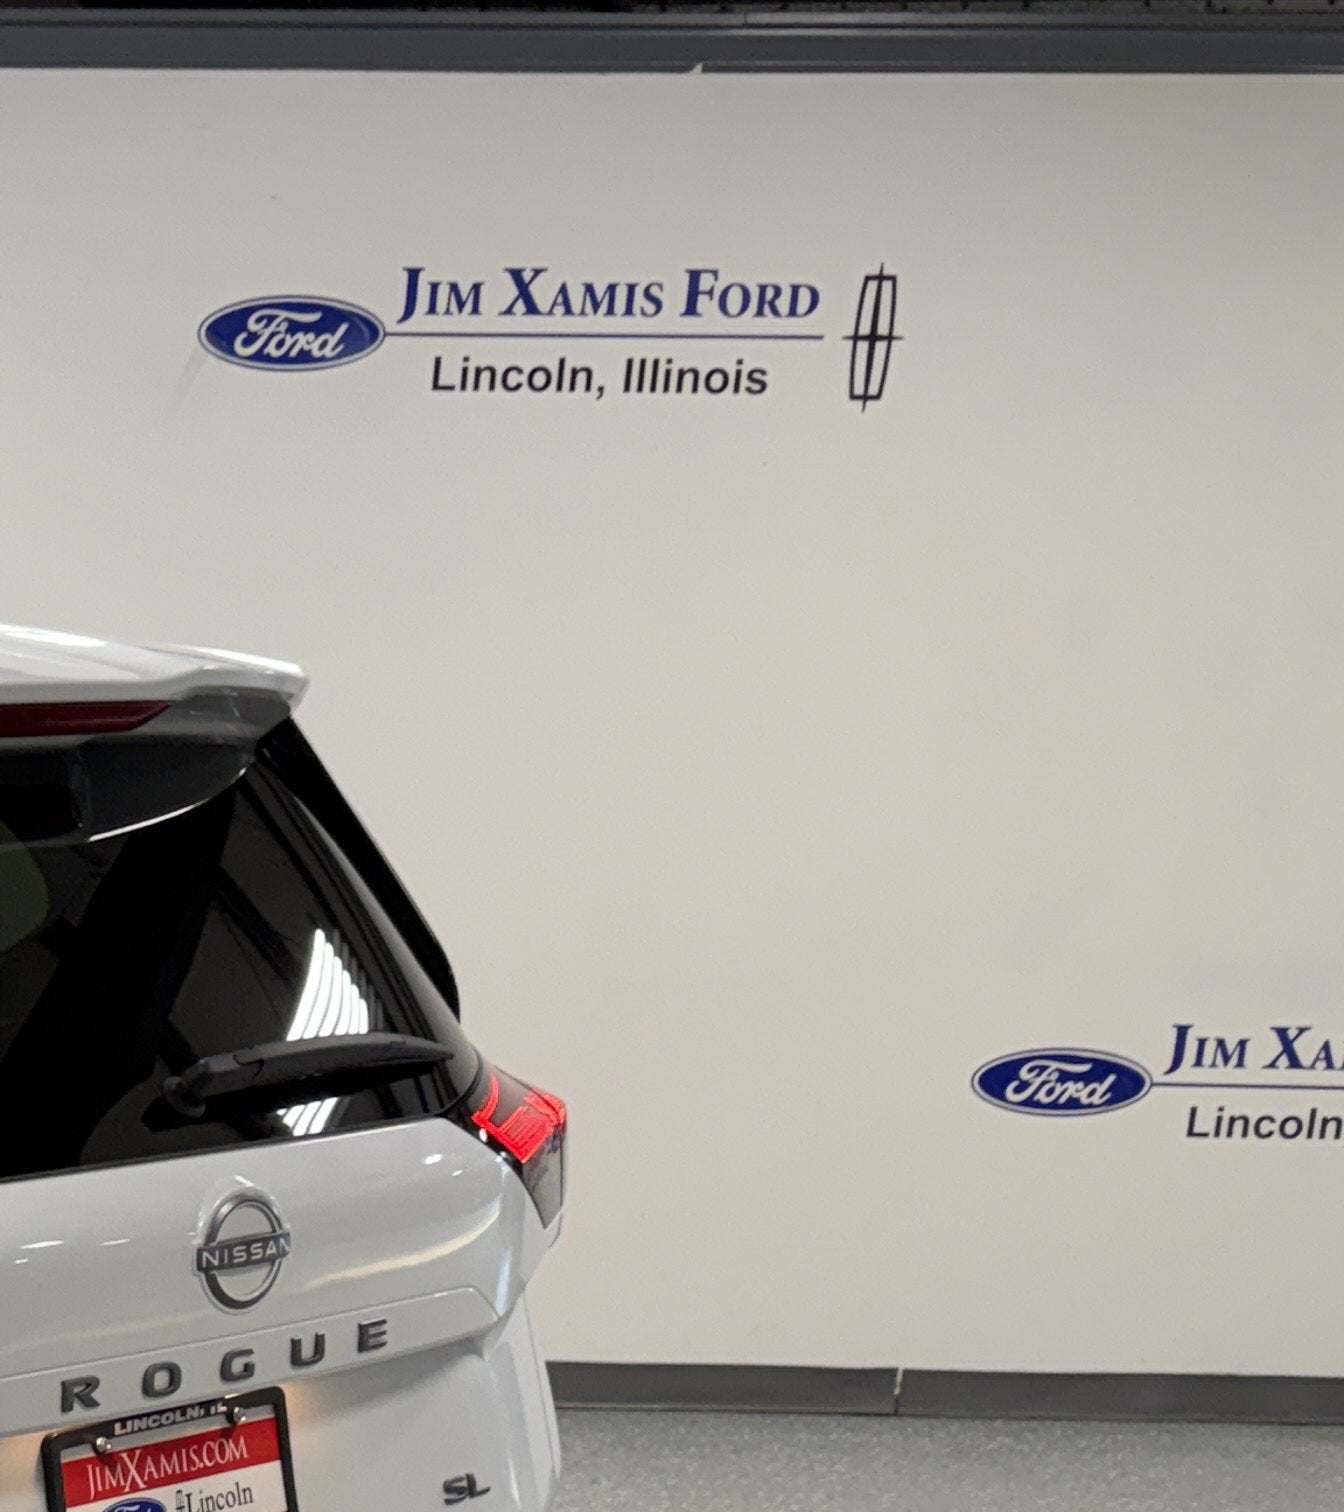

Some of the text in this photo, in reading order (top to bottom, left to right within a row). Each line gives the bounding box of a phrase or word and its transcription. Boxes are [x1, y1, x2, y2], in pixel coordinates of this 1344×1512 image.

[234, 308, 349, 358] Ford
[431, 356, 768, 399] Lincoln, Illinois
[1262, 1026, 1344, 1071] XA
[1005, 1059, 1117, 1105] Ford
[201, 1237, 290, 1268] NISSAN
[61, 1318, 389, 1413] ROGUE
[113, 1405, 205, 1436] LINCOLN,
[442, 1472, 492, 1506] SL
